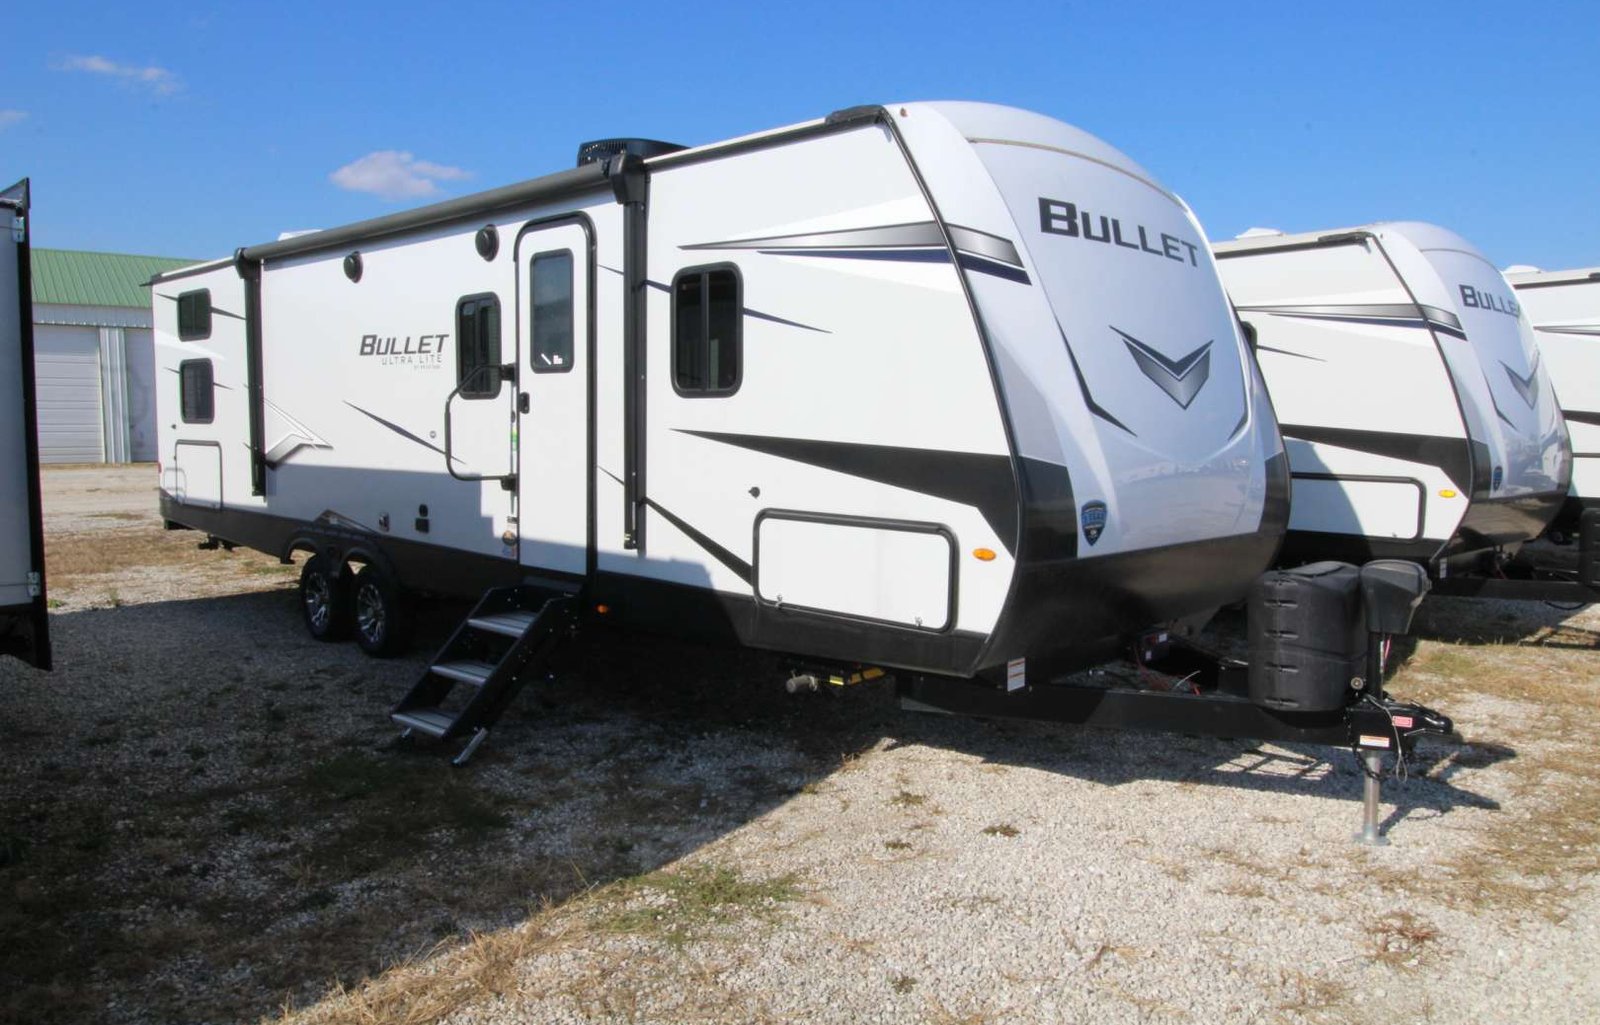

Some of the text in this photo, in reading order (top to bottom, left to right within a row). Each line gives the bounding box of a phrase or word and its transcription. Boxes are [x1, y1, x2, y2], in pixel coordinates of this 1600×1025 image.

[1038, 197, 1198, 268] BULLET
[359, 334, 450, 356] BULLET
[382, 354, 442, 366] ULTRA LITE
